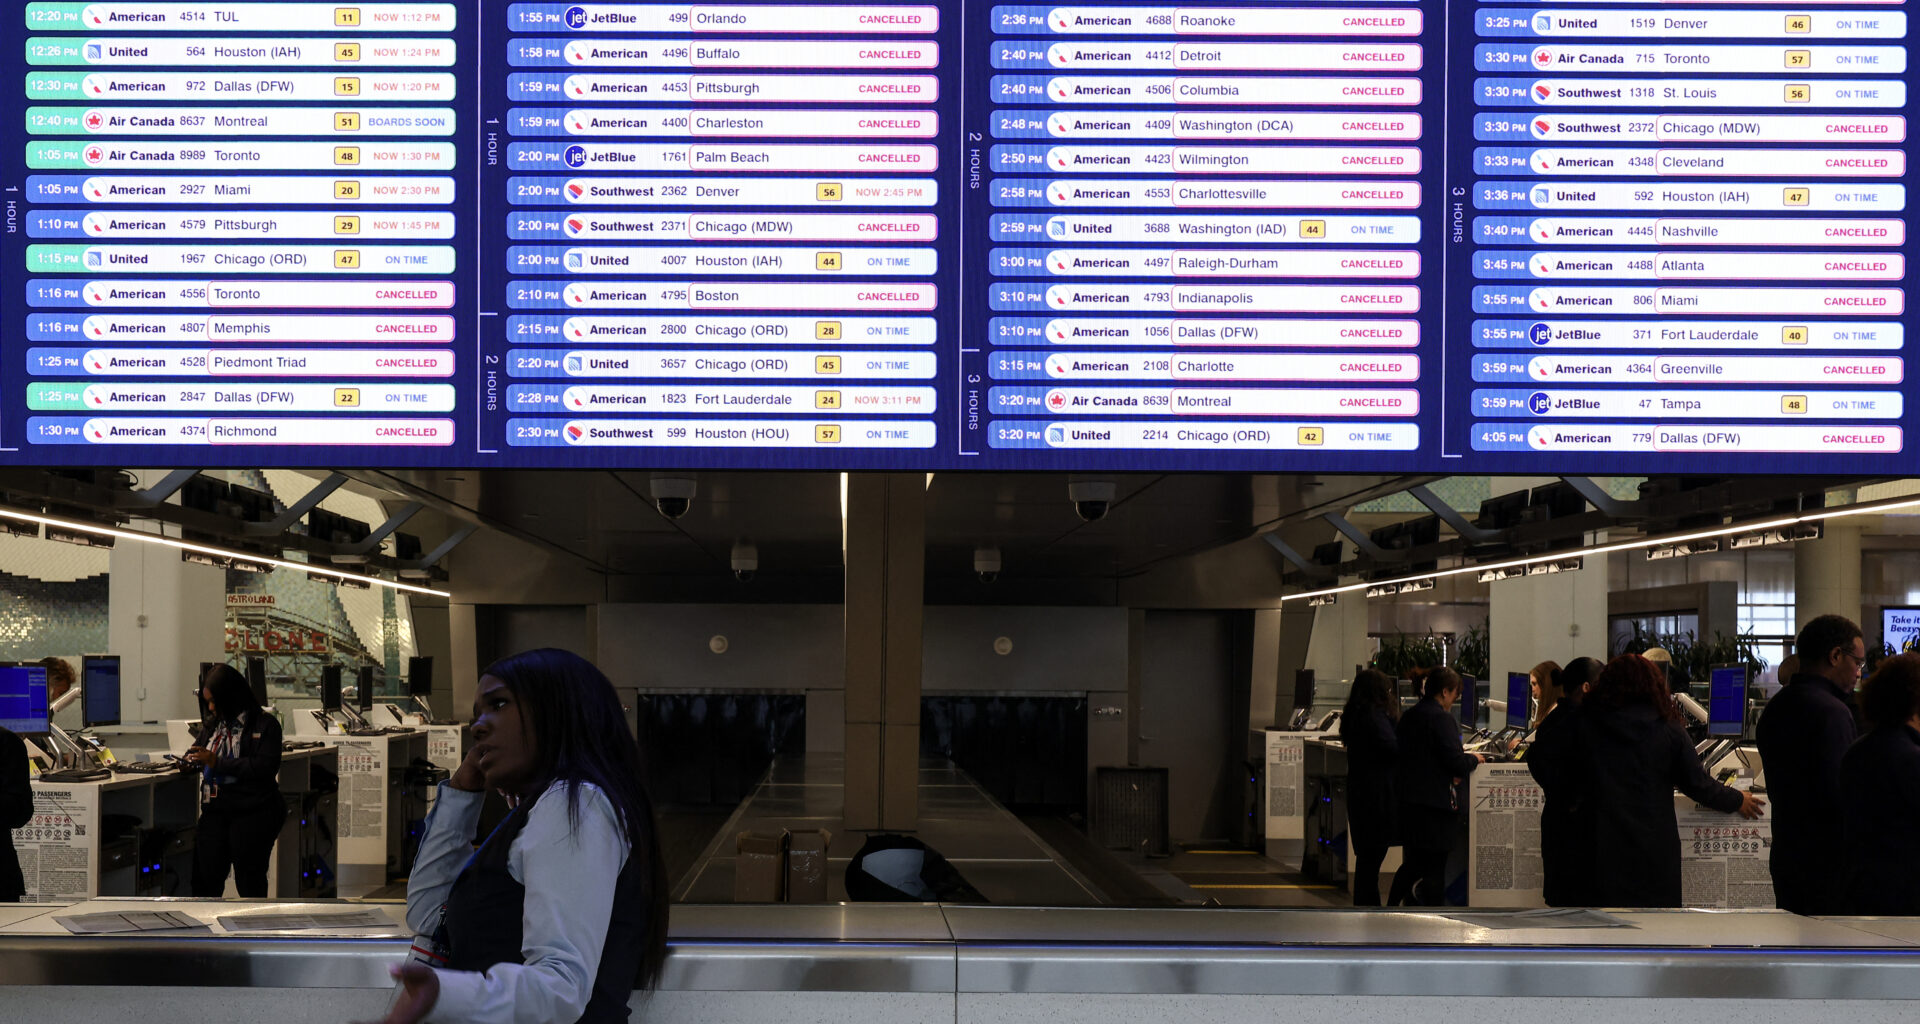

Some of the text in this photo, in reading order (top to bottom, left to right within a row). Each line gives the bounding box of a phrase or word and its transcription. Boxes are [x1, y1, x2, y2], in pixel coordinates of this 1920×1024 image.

[31, 10, 440, 22] 12:20 PM American 4514 TUL 11 NOW 1:12 PM
[519, 12, 543, 22] 1:55
[546, 14, 560, 22] PM
[591, 13, 637, 23] JetBlue
[669, 13, 688, 23] 499
[697, 13, 746, 24] Orlando
[859, 15, 922, 24] CANCELLED
[1002, 14, 1026, 25] 2:36
[1075, 16, 1131, 25] American
[1146, 15, 1172, 25] 4688
[1181, 15, 1235, 26] Roanoke
[1343, 18, 1405, 27] CANCELLED
[1485, 52, 1879, 64] 3:30 PM Air Canada 715 Toronto 57 ON TIME
[31, 115, 445, 127] 12:40 PM Air Canada 8637 Montreal 51 BOARDS SOON
[1001, 119, 1404, 133] 2:48 PM American 4409 Washington (DCA) CANCELLED
[1485, 121, 1888, 136] 3:30 PM Southwest 2372 Chicago (MDW) CANCELLED
[488, 133, 497, 165] HOUR
[518, 151, 543, 161] 2:00
[545, 153, 559, 161] PM
[590, 152, 636, 162] JetBlue
[663, 152, 686, 161] 1761
[696, 152, 726, 162] Palm
[731, 152, 769, 162] Beach
[858, 154, 920, 163] CANCELLED
[969, 132, 982, 189] 2 HOURS
[7, 201, 16, 233] HOUR
[1453, 187, 1465, 243] 3 HOURS
[1000, 222, 1394, 237] 2:59 PM United 3688 Washington (IAD) 44 ON TIME
[1484, 259, 1887, 271] 3:45 PM American 4488 Atlanta CANCELLED
[38, 288, 438, 299] 1:16 PM American 4556 Toronto CANCELLED
[1000, 291, 1025, 302] 3:10
[1073, 293, 1129, 302] American
[1144, 292, 1170, 302] 4793
[1179, 293, 1253, 306] Indianapolis
[1340, 295, 1403, 304] CANCELLED
[517, 323, 910, 338] 2:15 PM American 2800 Chicago (ORD) 28 ON TIME
[1483, 328, 1507, 339] 3:55
[1510, 331, 1524, 339] PM
[1555, 330, 1601, 340] JetBlue
[1633, 329, 1651, 339] 371
[1661, 329, 1685, 340] Fort
[1689, 330, 1758, 340] Lauderdale
[1789, 332, 1801, 340] 40
[1833, 332, 1849, 340] ON
[1852, 332, 1876, 340] TIME
[486, 355, 499, 411] 2 HOURS
[517, 393, 921, 405] 2:28 PM American 1823 Fort Lauderdale 24 NOW 3:11 PM
[968, 374, 981, 430] 3 HOURS
[999, 395, 1402, 407] 3:20 PM Air Canada 8639 Montreal CANCELLED
[39, 425, 437, 437] 1:30 PM American 4374 Richmond CANCELLED
[228, 595, 275, 604] ASTROLAND
[1891, 615, 1912, 624] Take
